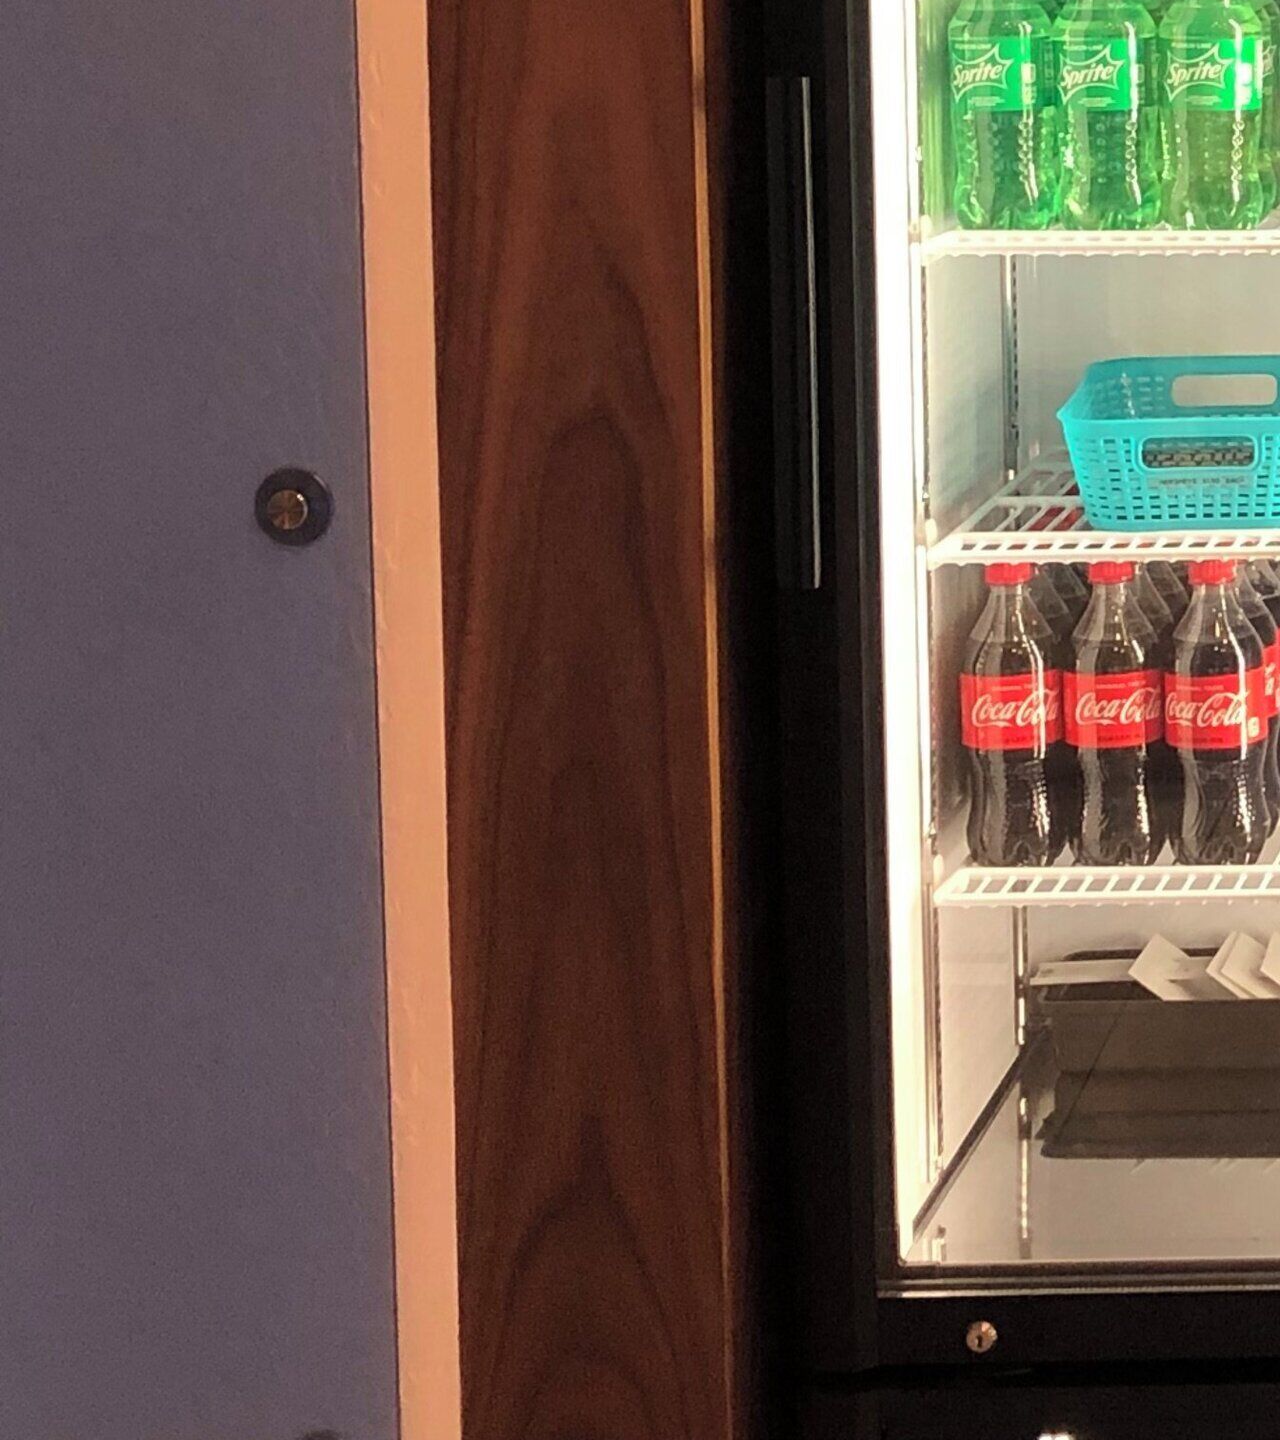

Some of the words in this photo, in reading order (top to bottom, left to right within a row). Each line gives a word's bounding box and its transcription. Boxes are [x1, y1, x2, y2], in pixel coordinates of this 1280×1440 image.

[953, 61, 1003, 88] Sprite
[1061, 62, 1114, 89] Sprite
[1166, 61, 1222, 87] Sprite
[972, 688, 1060, 728] Coca-Cola
[1075, 687, 1163, 727] Coca-Cola
[1165, 691, 1250, 728] Coca-Cola
